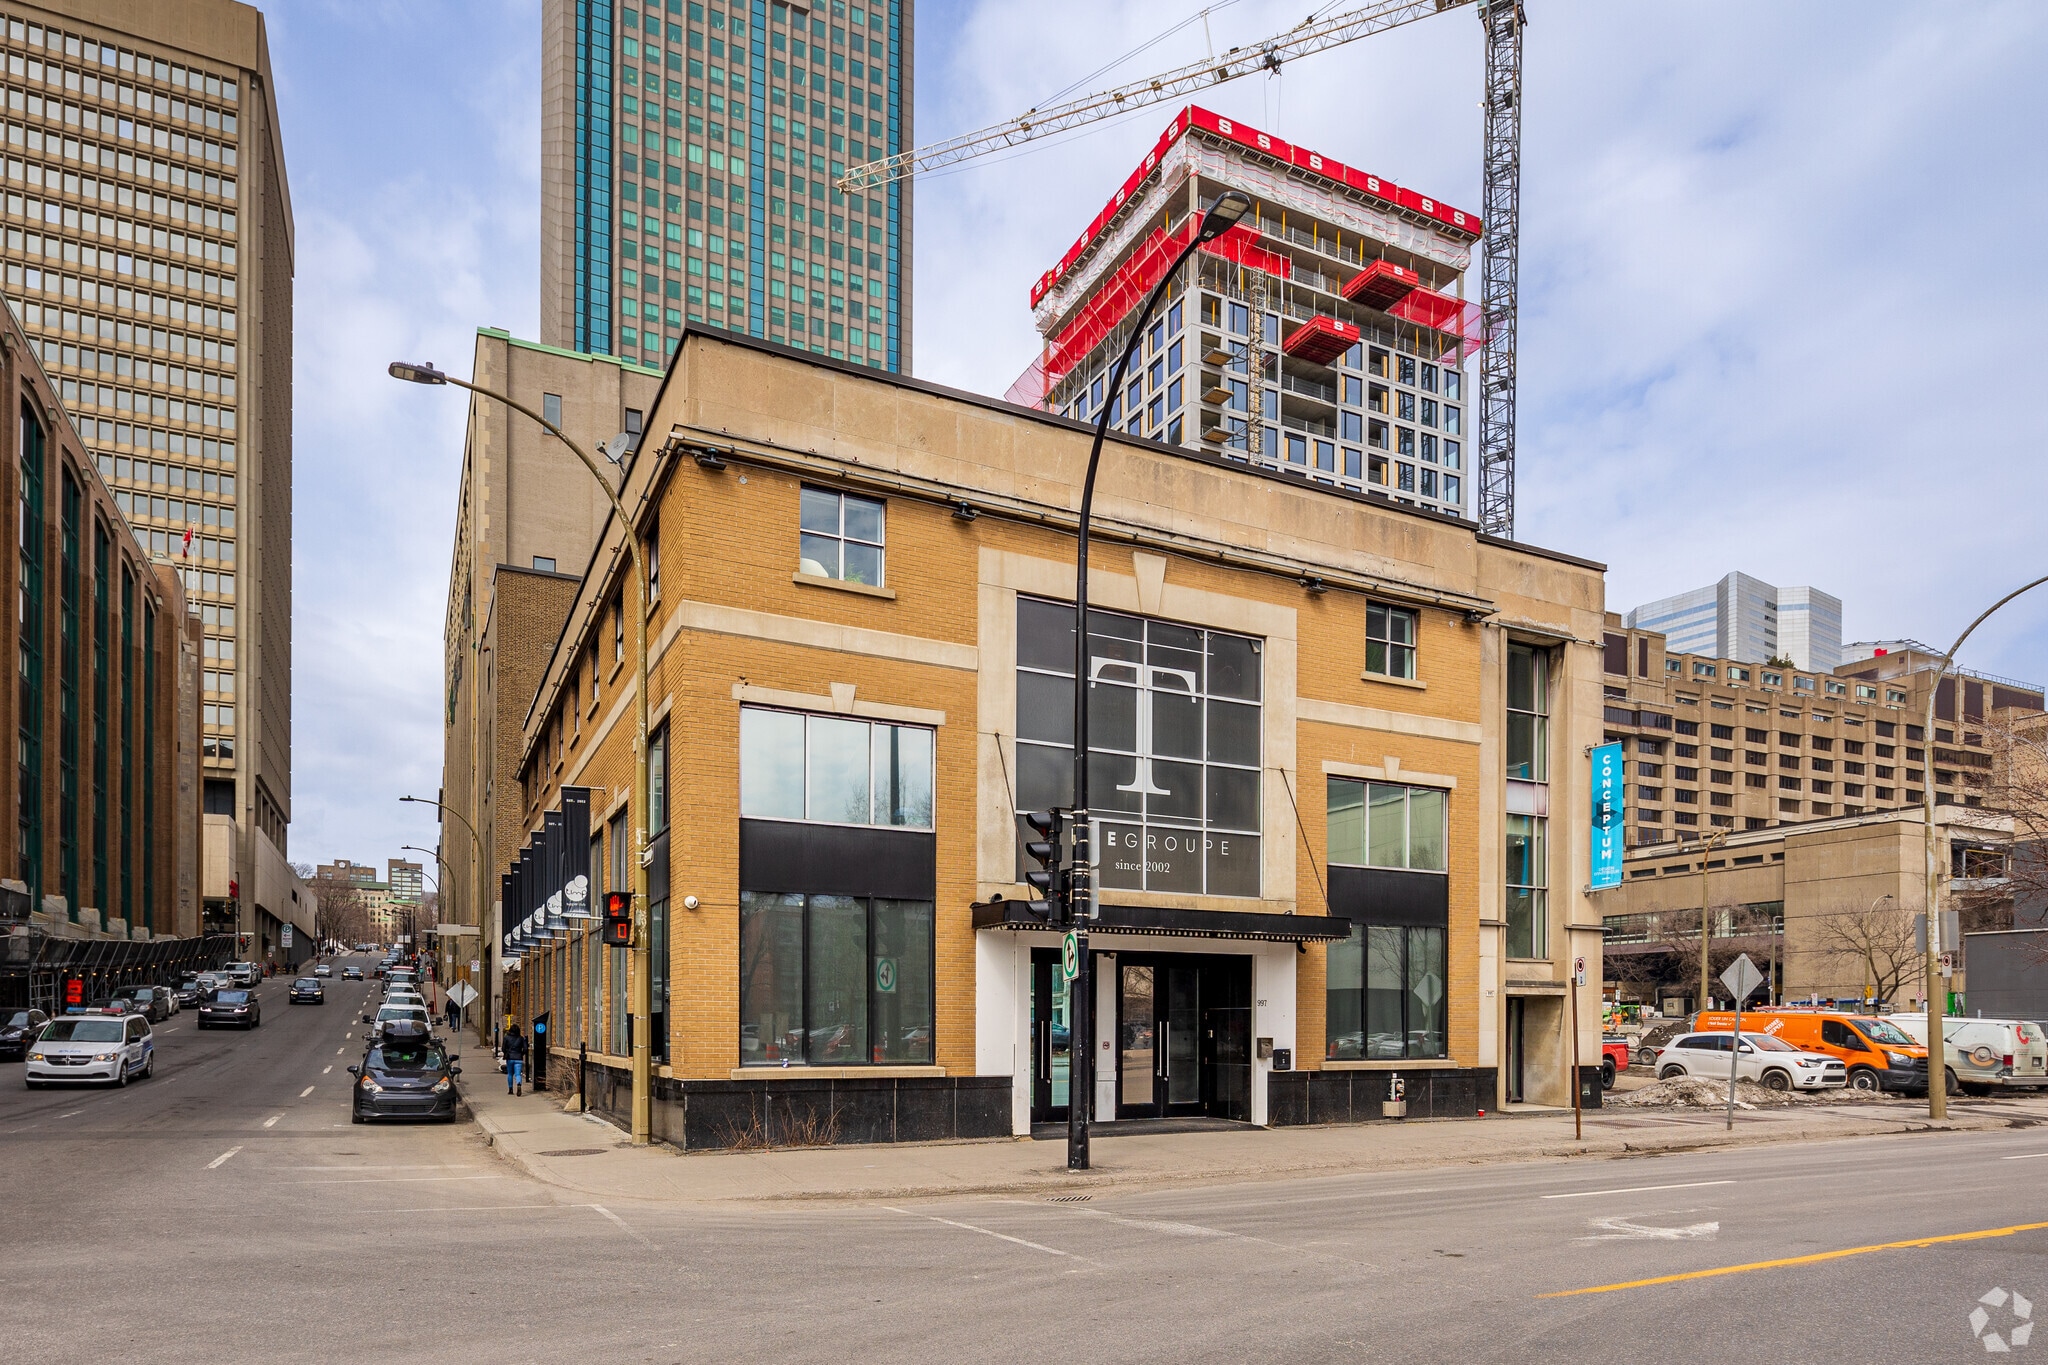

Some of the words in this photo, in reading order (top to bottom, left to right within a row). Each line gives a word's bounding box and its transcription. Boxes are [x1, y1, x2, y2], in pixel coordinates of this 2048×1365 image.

[1168, 120, 1179, 141] S
[1218, 118, 1233, 135] S
[1257, 133, 1271, 150] S
[1146, 151, 1156, 171] S
[1309, 154, 1322, 170] S
[1367, 177, 1380, 192] S
[1116, 188, 1125, 206] S
[1422, 198, 1434, 213] S
[1454, 211, 1466, 226] S
[1080, 231, 1089, 248] S
[1055, 262, 1063, 278] S
[1394, 266, 1403, 276] S
[1035, 280, 1043, 296] S
[1333, 321, 1344, 331] S
[1090, 656, 1197, 796] T
[1602, 754, 1612, 859] CONCEPTUM
[1115, 859, 1142, 871] since
[1145, 861, 1170, 873] 2002
[1257, 999, 1268, 1007] 997
[1764, 1018, 1780, 1032] HOME
